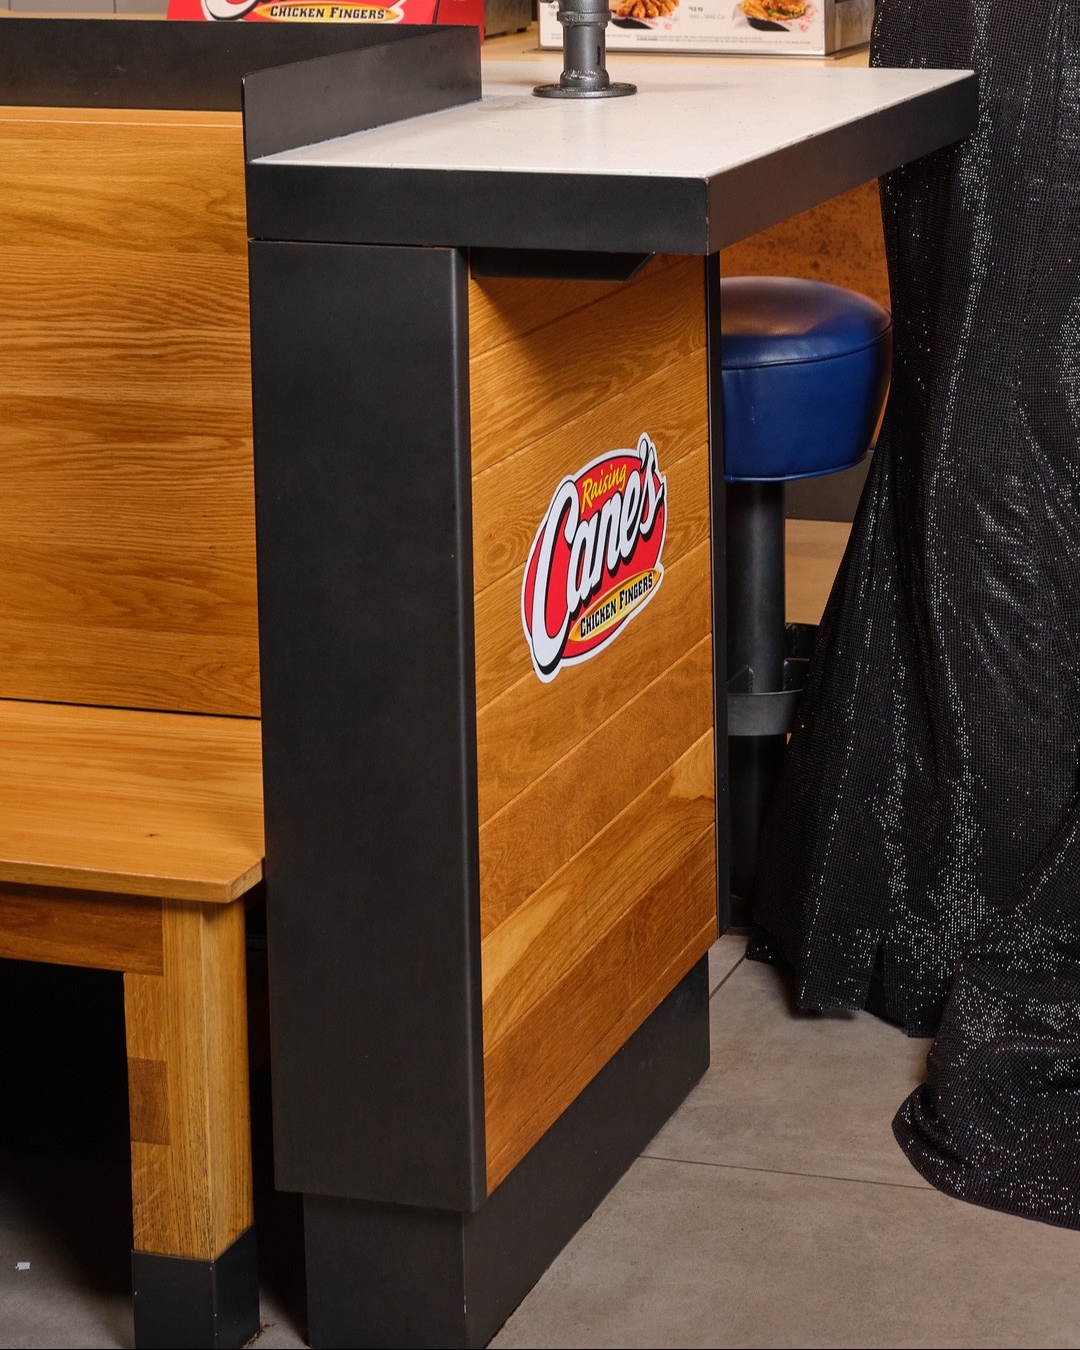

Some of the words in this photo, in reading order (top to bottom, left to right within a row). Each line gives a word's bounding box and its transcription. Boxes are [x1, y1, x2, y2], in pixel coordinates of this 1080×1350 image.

[270, 6, 325, 18] CHICKEN
[330, 6, 385, 20] FINGERS
[581, 463, 627, 514] Raising
[532, 438, 664, 675] Cane's
[580, 600, 617, 638] CHICKEN
[619, 573, 653, 610] FINGERS
